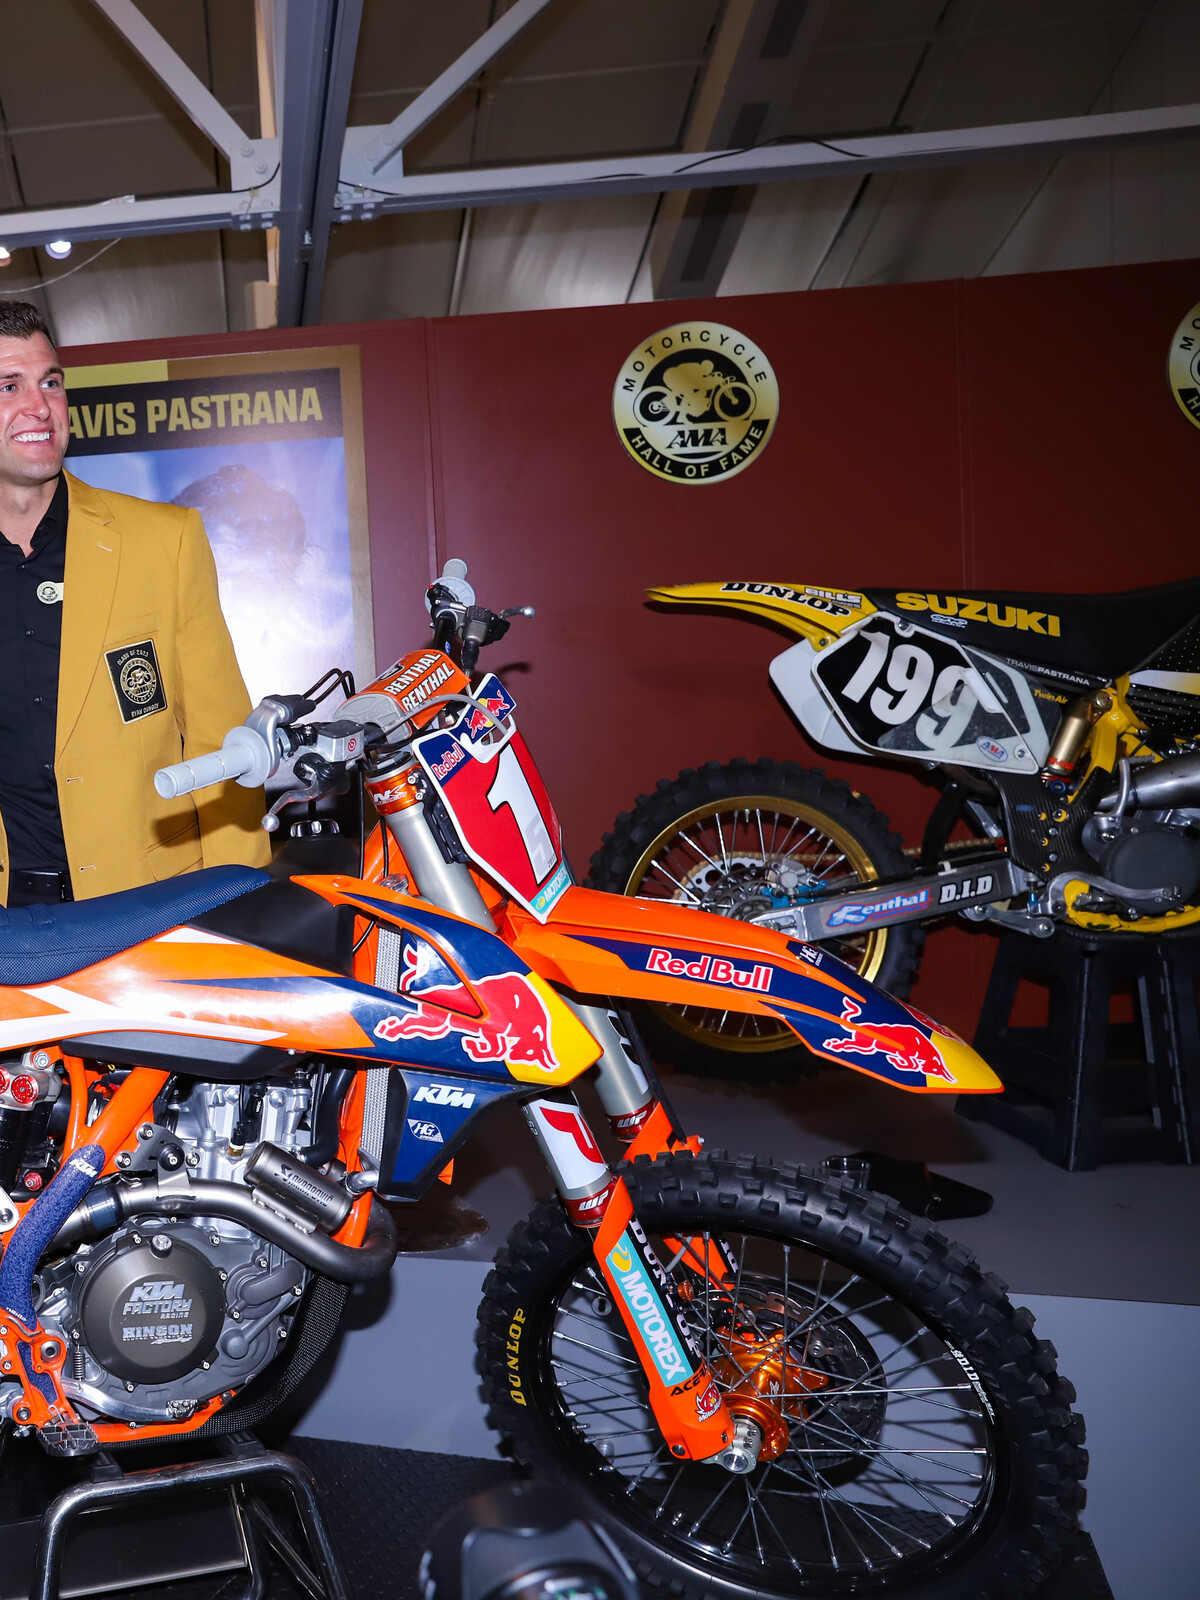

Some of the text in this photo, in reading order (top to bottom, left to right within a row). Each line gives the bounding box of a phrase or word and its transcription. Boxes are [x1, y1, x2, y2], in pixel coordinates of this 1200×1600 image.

[622, 330, 767, 392] MOTORCYCLE
[68, 387, 323, 440] AVIS PASTRANA
[631, 427, 763, 477] HALL OF FAME
[665, 428, 729, 449] AMA
[721, 582, 851, 616] DUNLOP
[895, 592, 1061, 637] SUZUKI
[383, 653, 442, 696] RENTHAL
[401, 662, 455, 712] RENTHAL
[841, 626, 976, 751] 199
[486, 742, 558, 887] 1
[939, 875, 993, 904] D.I.D
[645, 947, 773, 993] Red Bull
[413, 1083, 476, 1109] KTM
[69, 1158, 98, 1178] KTM
[123, 1299, 192, 1315] FACTORY
[129, 1281, 185, 1301] KTM
[122, 1324, 192, 1338] HINSON
[620, 1270, 686, 1382] MOTOREX
[506, 1308, 527, 1406] DUNLOP
